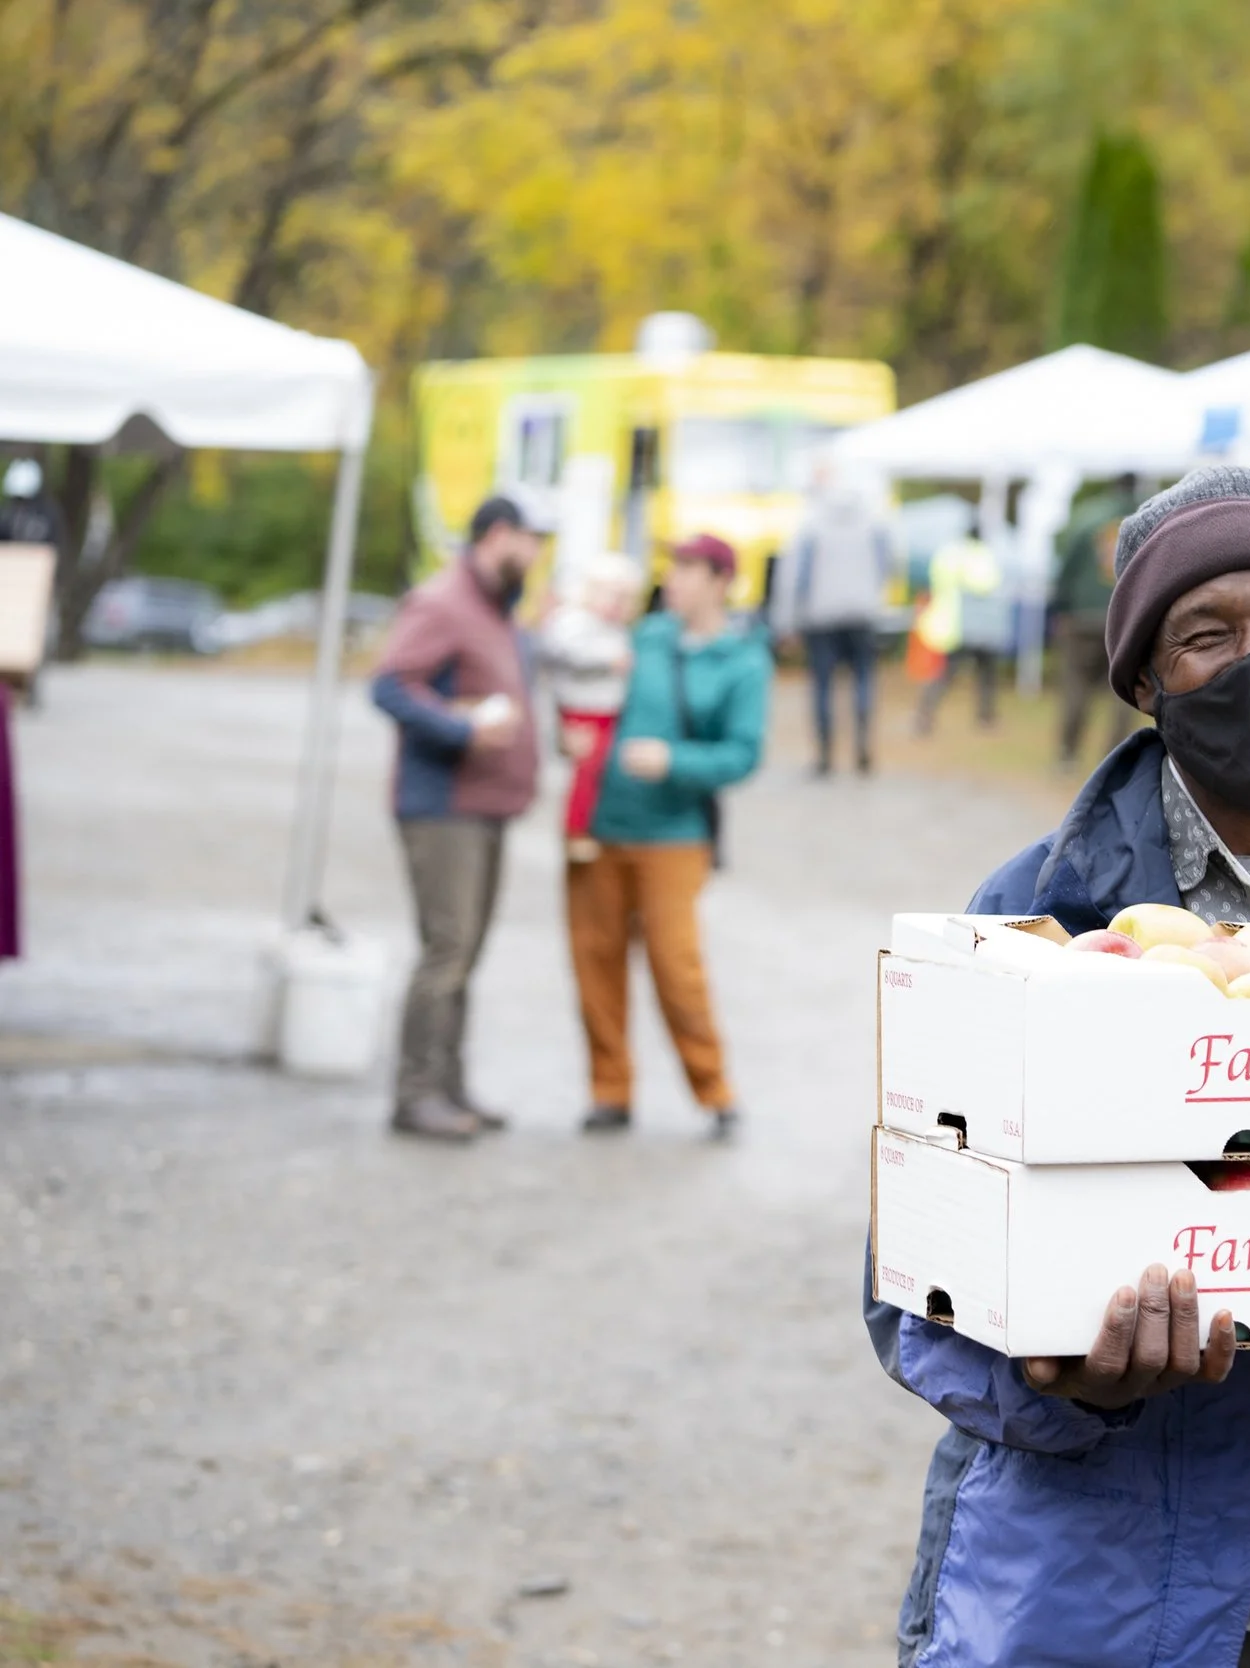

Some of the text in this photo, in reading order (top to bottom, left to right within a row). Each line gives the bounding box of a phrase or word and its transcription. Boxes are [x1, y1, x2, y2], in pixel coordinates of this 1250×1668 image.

[889, 971, 913, 988] QUARTS
[886, 1091, 924, 1113] PRODUCE OF
[882, 1265, 915, 1292] PRODUCE OF
